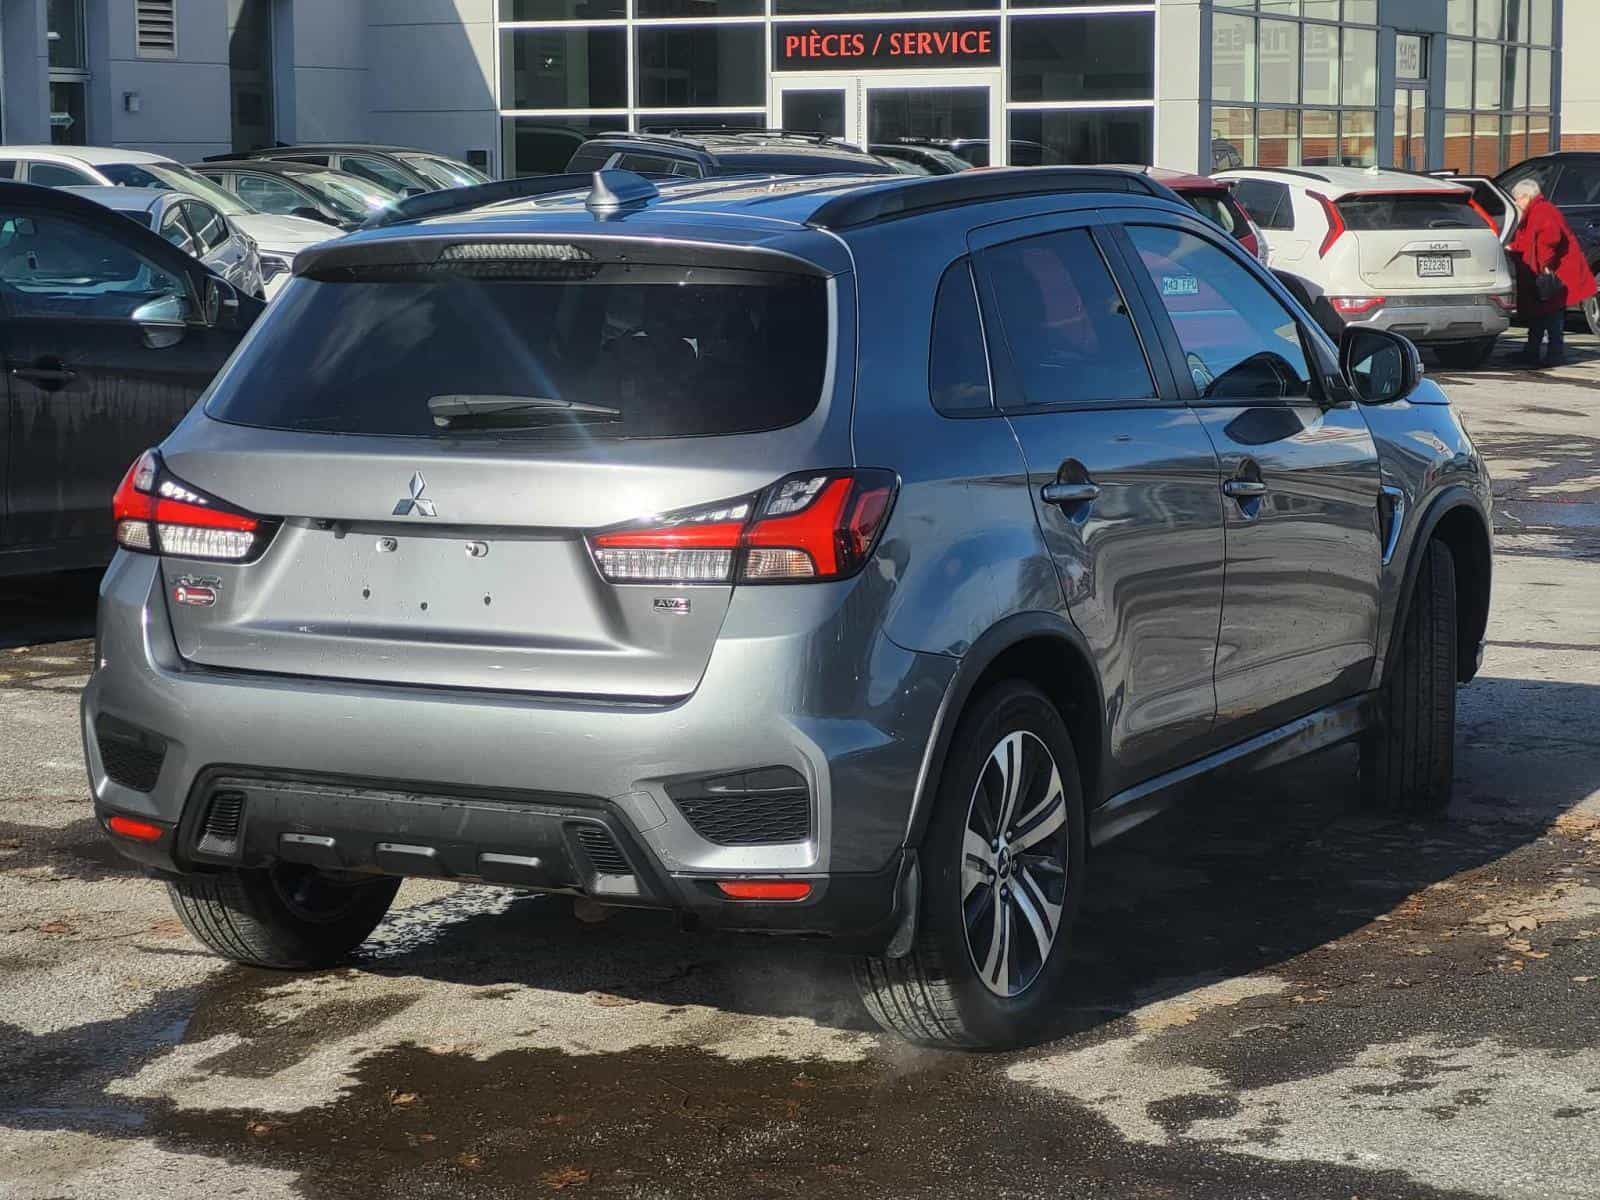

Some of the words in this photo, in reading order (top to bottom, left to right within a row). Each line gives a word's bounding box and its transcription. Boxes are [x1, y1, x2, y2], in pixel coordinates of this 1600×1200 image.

[785, 28, 865, 58] PIÈCES
[871, 33, 883, 56] /
[889, 30, 991, 56] SERVICE
